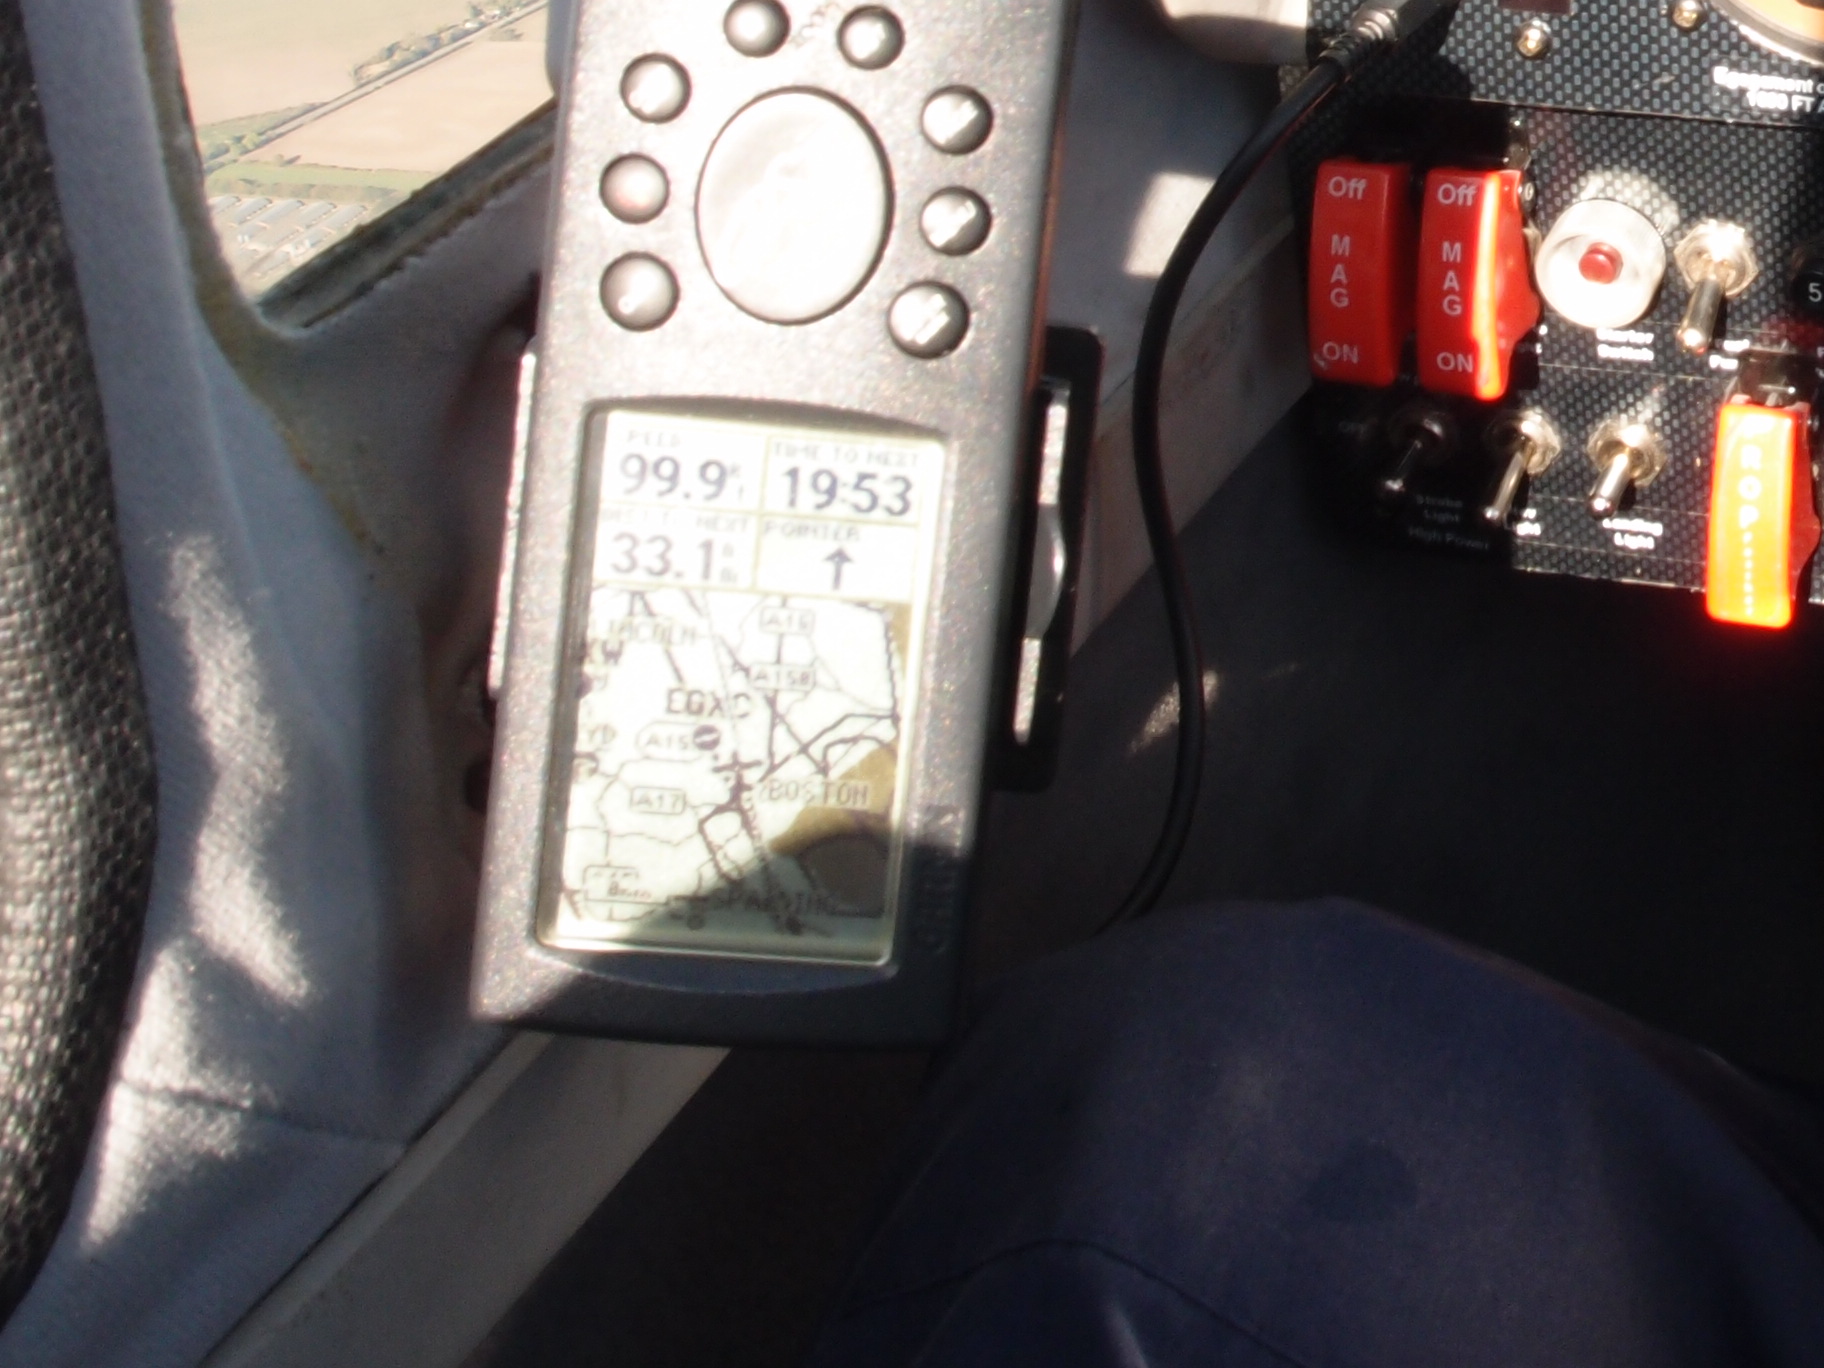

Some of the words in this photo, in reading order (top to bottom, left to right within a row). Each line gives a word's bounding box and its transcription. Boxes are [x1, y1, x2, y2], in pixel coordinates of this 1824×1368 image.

[1791, 95, 1815, 113] FT
[1327, 175, 1368, 201] Off
[1437, 183, 1478, 207] Off
[1329, 233, 1351, 308] MAG
[1441, 240, 1463, 317] MAG
[1808, 281, 1824, 303] 5
[1322, 341, 1360, 365] ON
[1436, 351, 1475, 373] ON
[618, 452, 729, 503] 99.9
[782, 465, 915, 518] 19:53
[610, 531, 715, 582] 33.1
[765, 780, 870, 806] BOSTON
